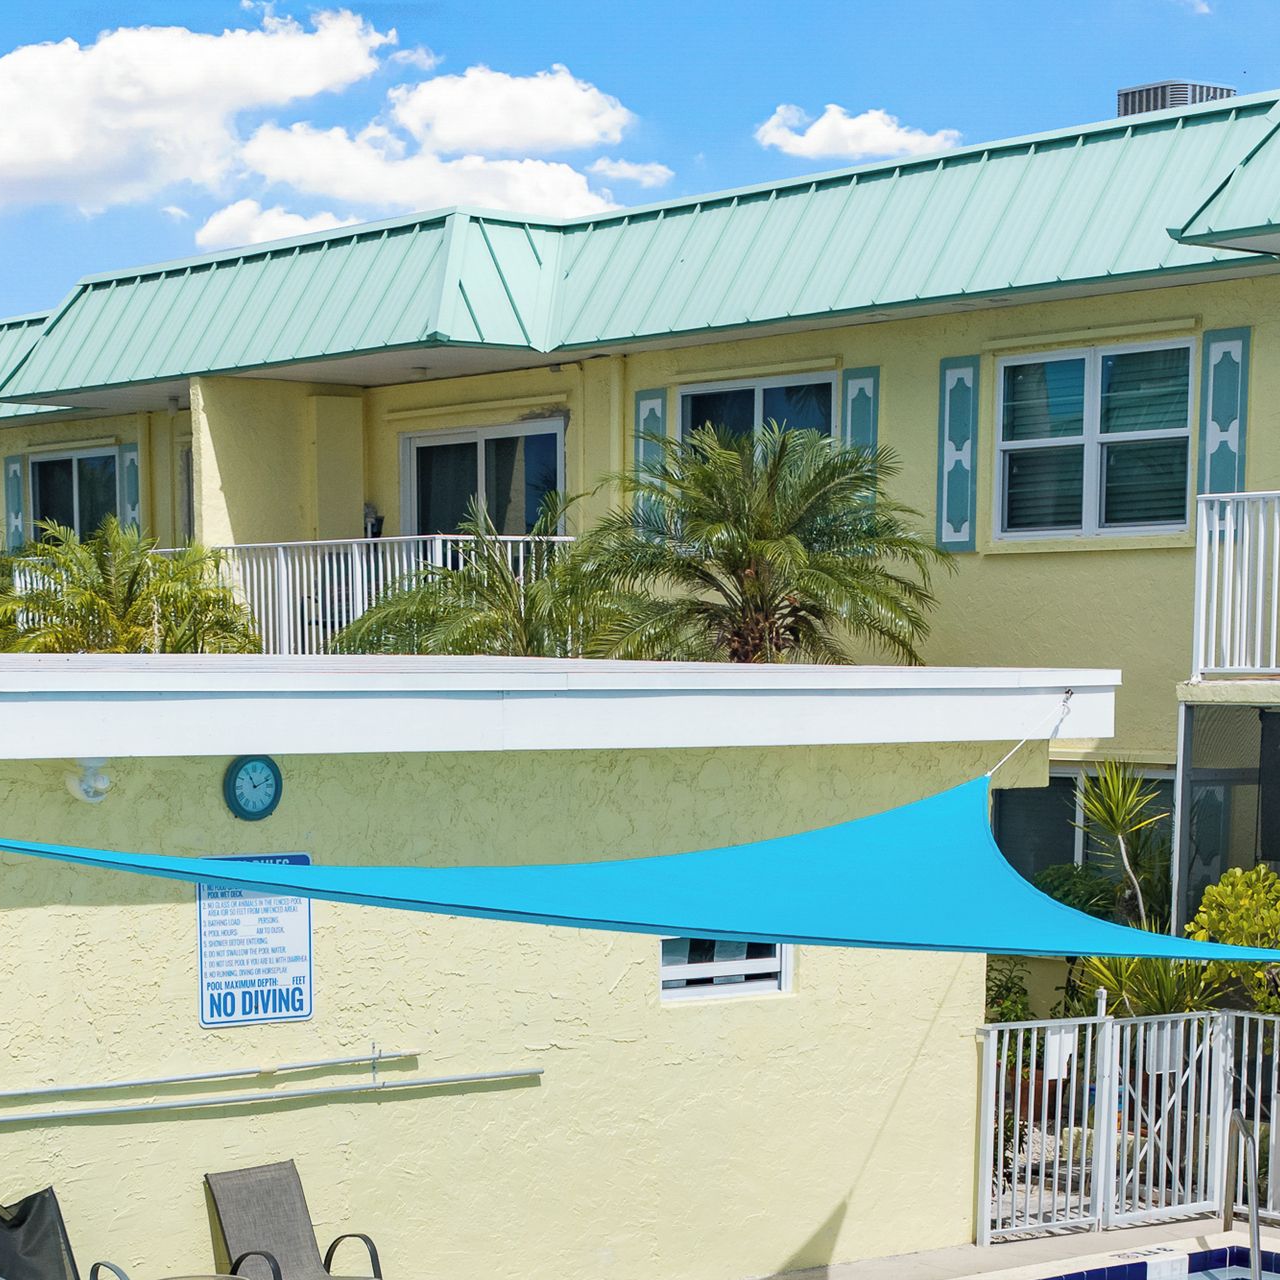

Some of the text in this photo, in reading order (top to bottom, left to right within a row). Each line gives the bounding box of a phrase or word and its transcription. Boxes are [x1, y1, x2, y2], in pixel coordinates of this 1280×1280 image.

[207, 976, 306, 991] POOL MAXIMUM DEPTH: FEET
[210, 987, 304, 1018] NO DIVING
